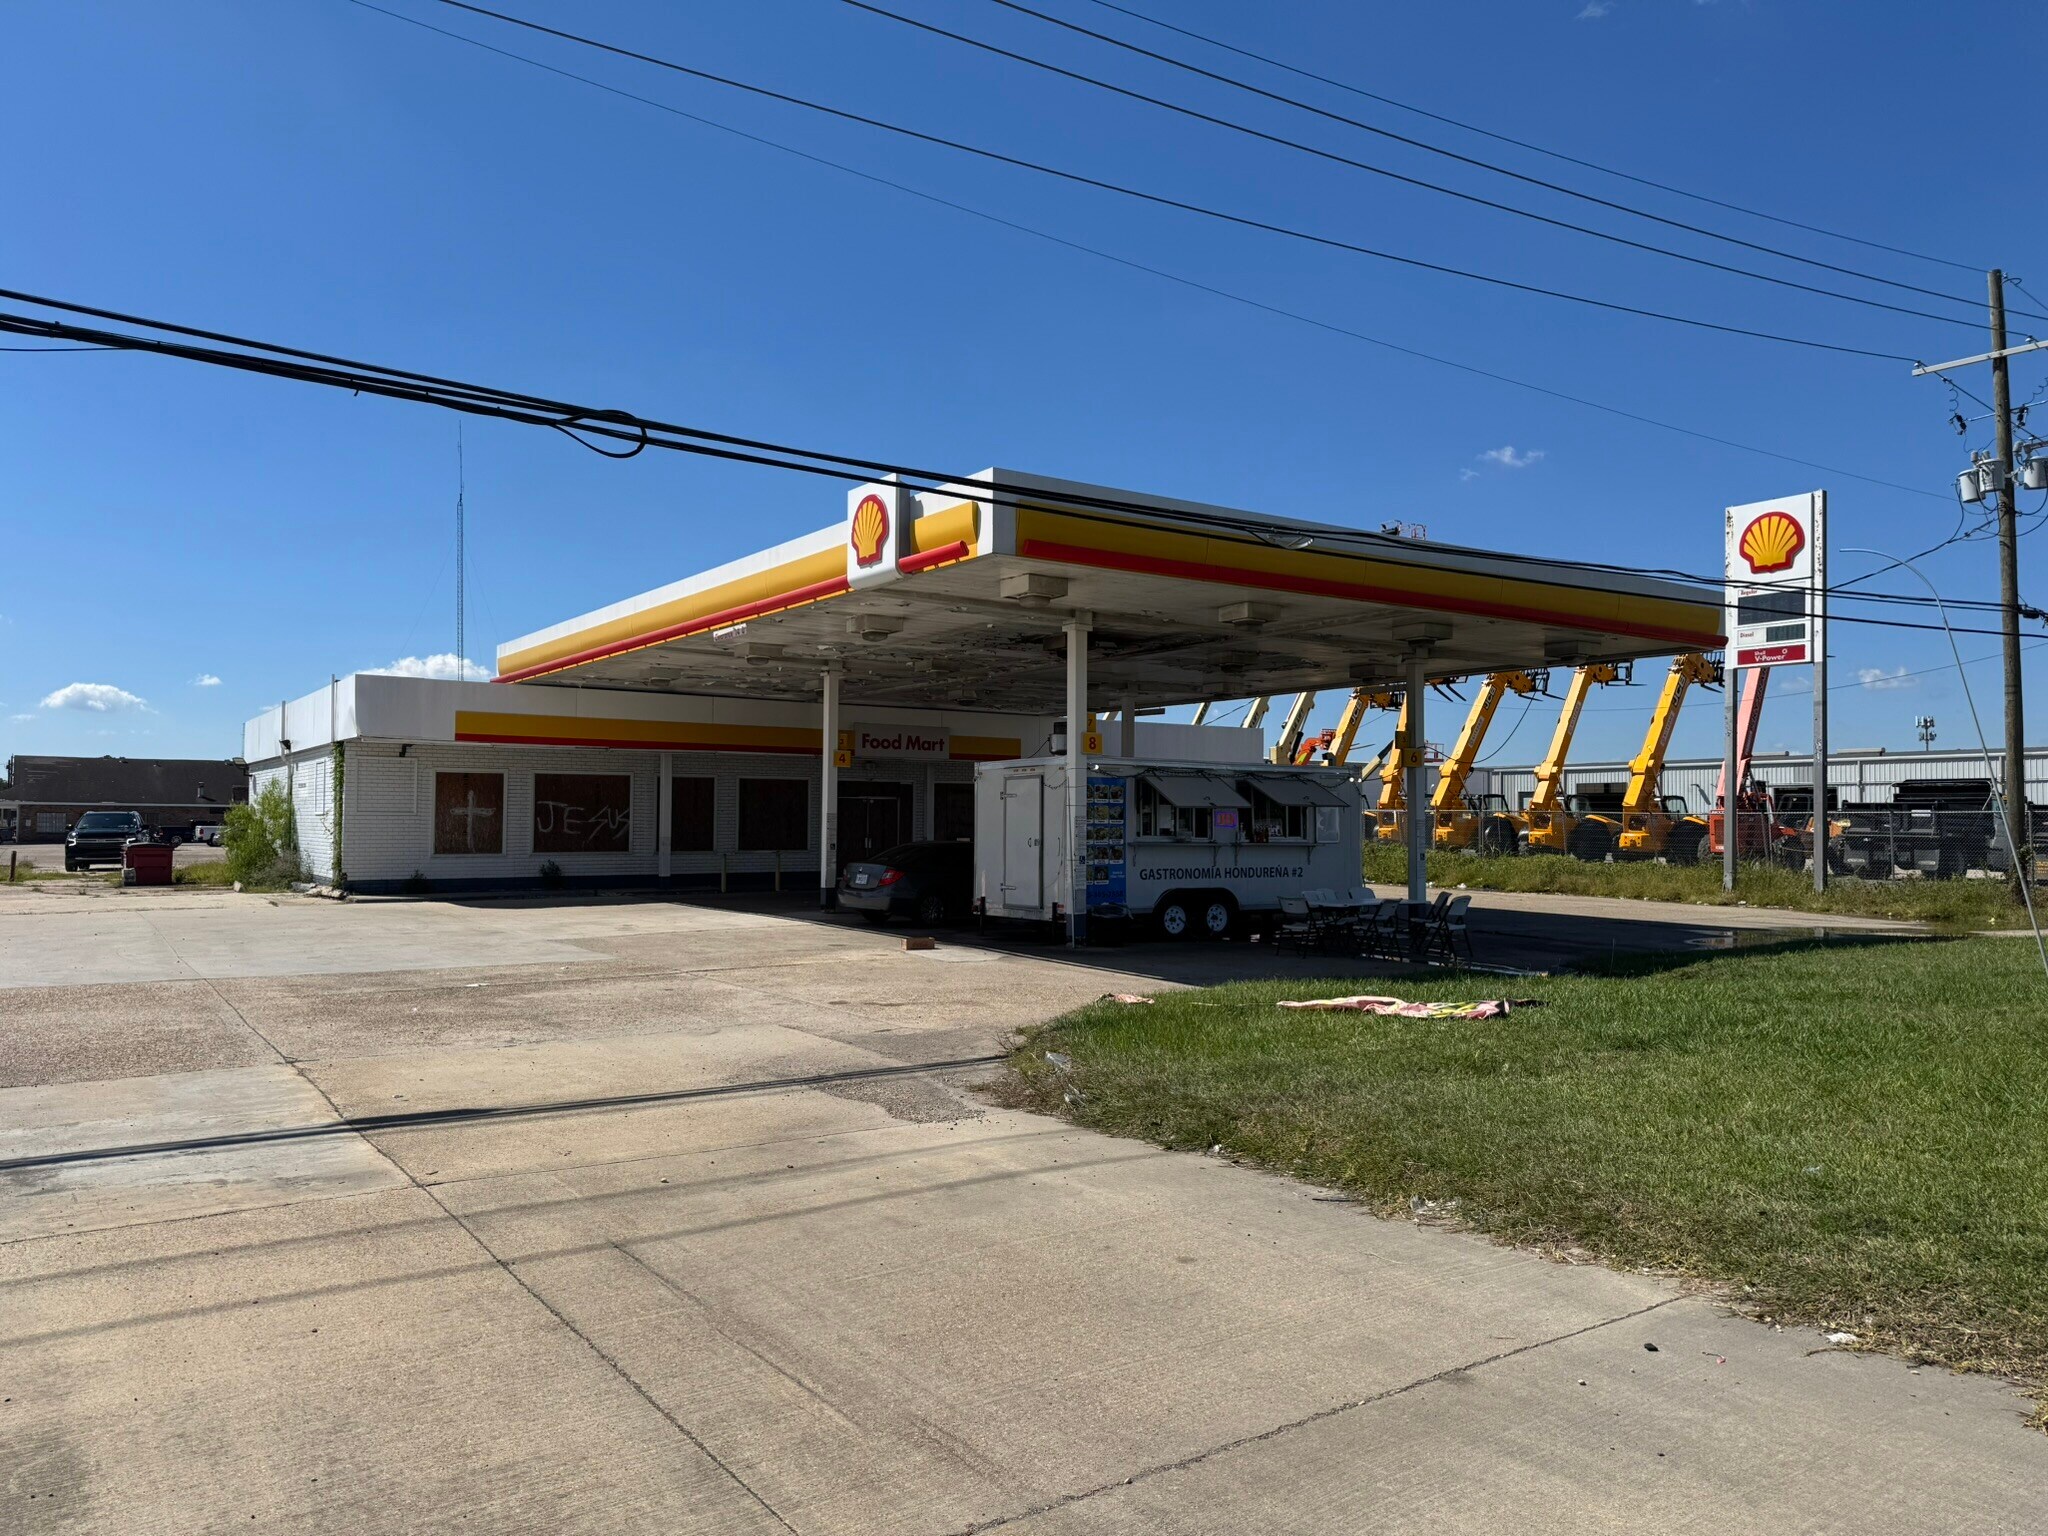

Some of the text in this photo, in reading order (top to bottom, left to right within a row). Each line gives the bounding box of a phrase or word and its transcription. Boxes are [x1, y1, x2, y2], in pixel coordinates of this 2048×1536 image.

[1754, 654, 1786, 662] V-Power
[1484, 685, 1497, 710] JCB
[1673, 674, 1687, 706] JCB
[1350, 700, 1363, 725] JCB
[862, 733, 902, 750] Food
[905, 735, 945, 751] Mart
[1089, 736, 1096, 750] 8
[838, 753, 847, 763] 4
[1411, 751, 1418, 763] 6
[536, 800, 630, 842] JESUS
[1139, 865, 1221, 880] GASTRONOMÍA
[1224, 864, 1289, 879] HONDUREÑA
[1291, 866, 1304, 878] #2
